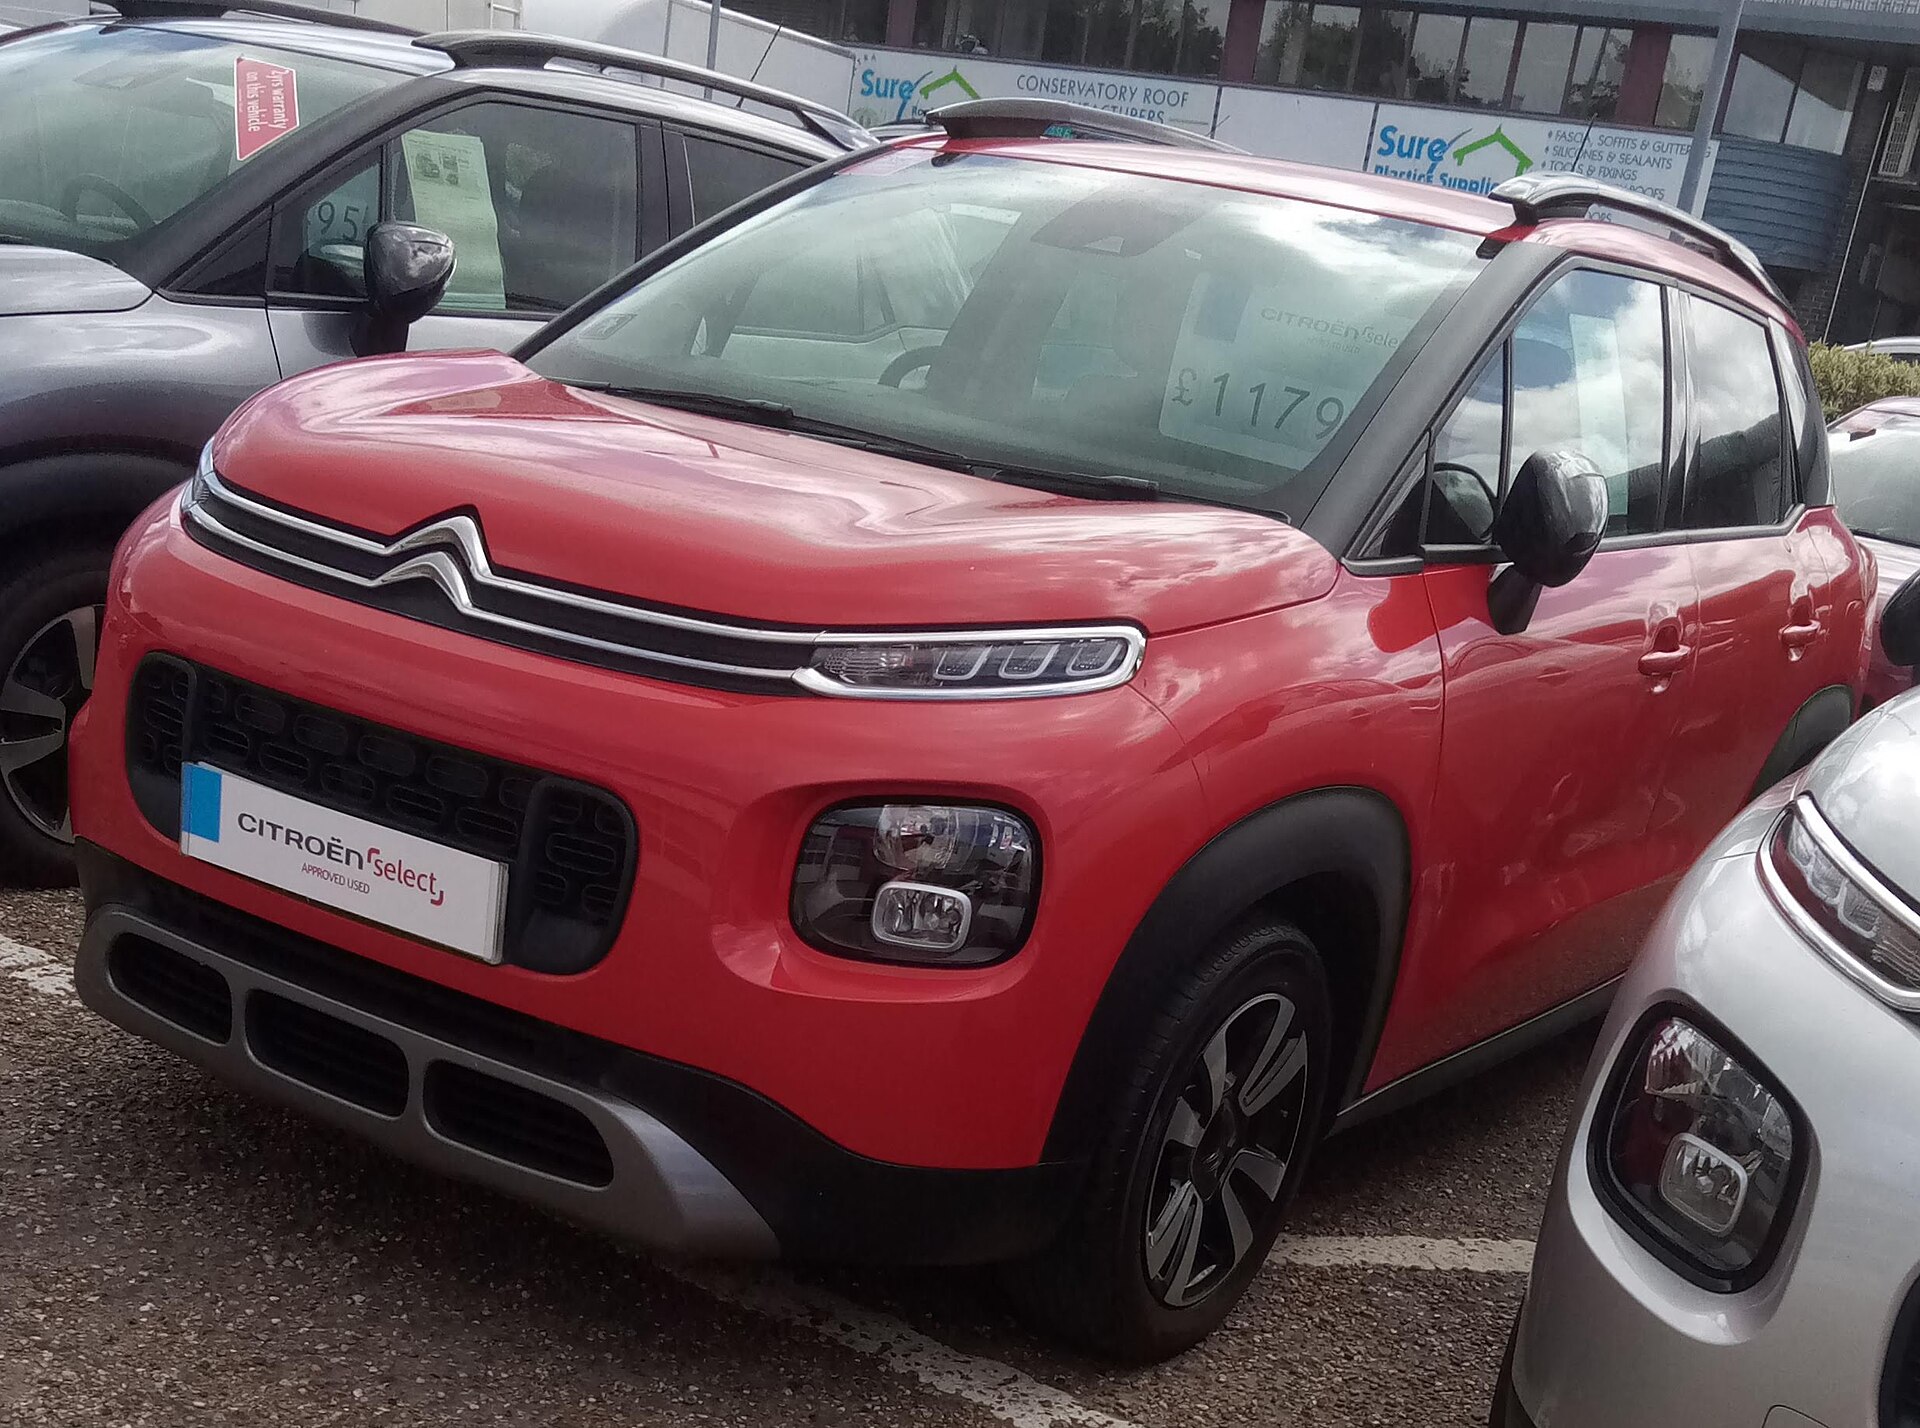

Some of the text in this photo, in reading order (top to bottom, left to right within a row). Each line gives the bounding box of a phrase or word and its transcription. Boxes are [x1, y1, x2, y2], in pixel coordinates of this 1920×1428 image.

[246, 71, 268, 132] on this vehicle
[266, 69, 289, 129] 2yrs warranty
[861, 69, 918, 103] Sure
[1016, 74, 1190, 107] CONSERVATORY ROOF
[1377, 125, 1451, 164] Sure
[1598, 134, 1638, 150] SOFFITS
[1639, 138, 1650, 151] &
[1550, 161, 1638, 181] TOOS & FIXINGS
[1606, 151, 1616, 163] &
[1618, 153, 1673, 170] SEALANTS
[301, 862, 371, 894] APPROVED USED
[372, 858, 439, 897] select
